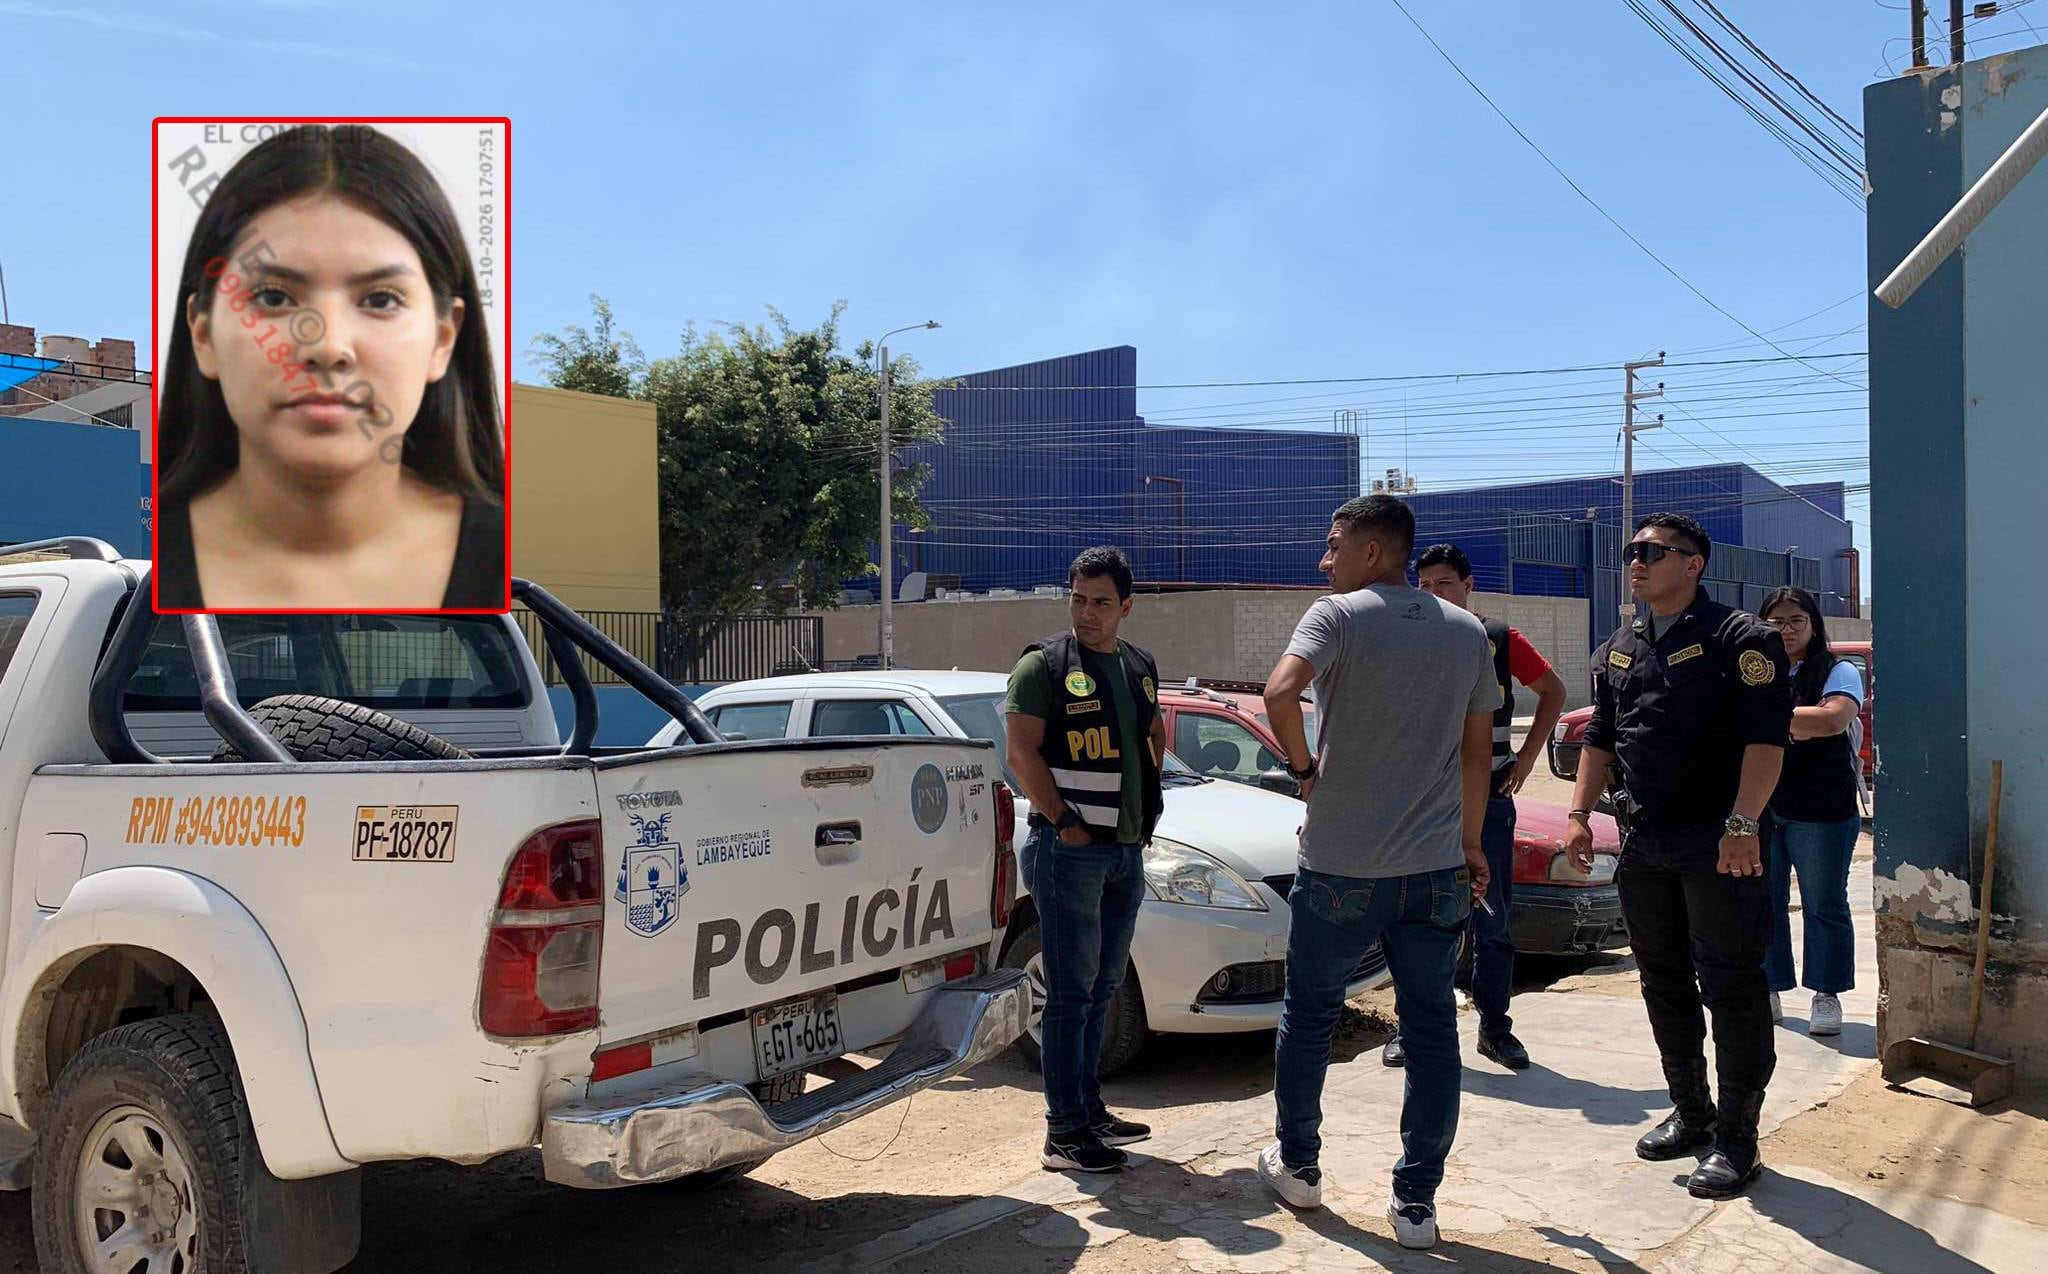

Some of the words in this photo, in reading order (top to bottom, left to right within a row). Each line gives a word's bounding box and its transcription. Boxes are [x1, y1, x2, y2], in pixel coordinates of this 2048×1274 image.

[1067, 726, 1120, 761] POL
[616, 790, 683, 811] TOYOTA
[917, 787, 944, 808] PNP
[125, 797, 173, 844] RPM
[174, 796, 306, 847] #943893443
[391, 808, 422, 820] PERU
[356, 821, 453, 859] PF-18787
[696, 835, 729, 847] GOBIERNO
[730, 831, 761, 842] REGIONAL
[697, 839, 771, 866] LAMBAYEQUE
[692, 866, 955, 1000] POLICÍA
